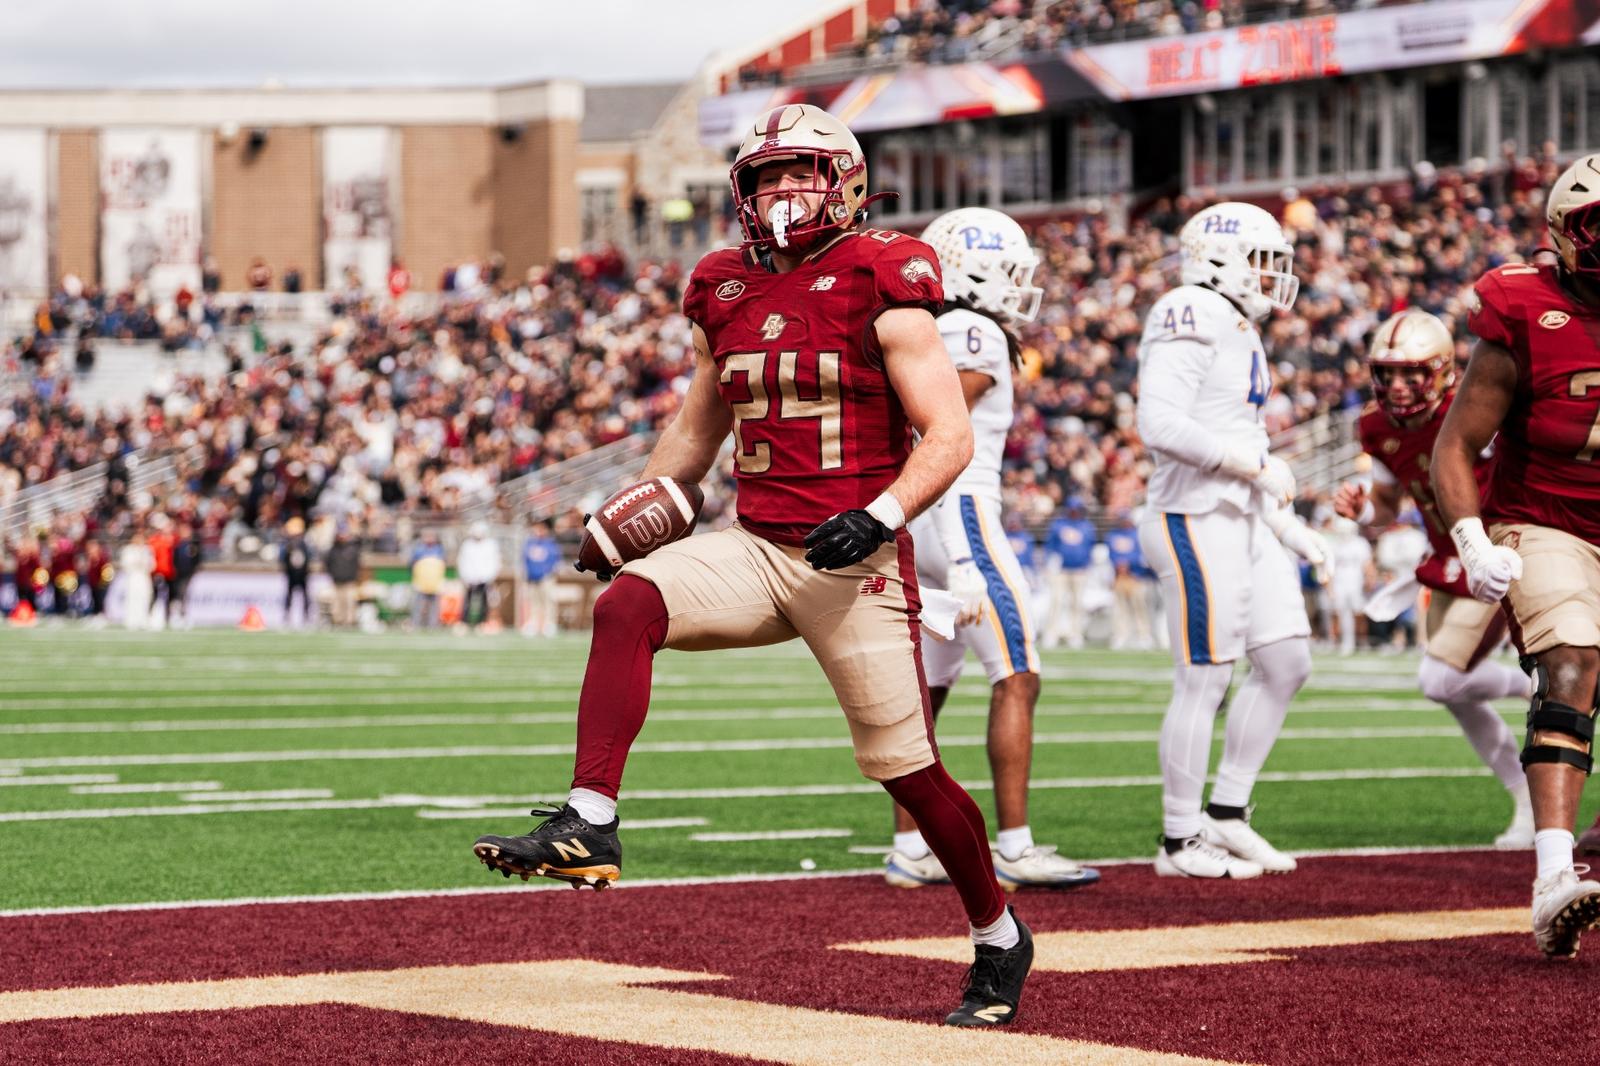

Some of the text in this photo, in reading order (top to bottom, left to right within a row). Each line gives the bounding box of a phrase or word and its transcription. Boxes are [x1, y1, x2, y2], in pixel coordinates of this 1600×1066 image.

[1237, 14, 1342, 88] ZONE
[959, 226, 1005, 251] Pitt
[1204, 214, 1241, 235] Pitt
[718, 281, 742, 297] ACC
[1164, 304, 1196, 334] 44
[967, 326, 982, 354] 6
[719, 351, 843, 474] 24
